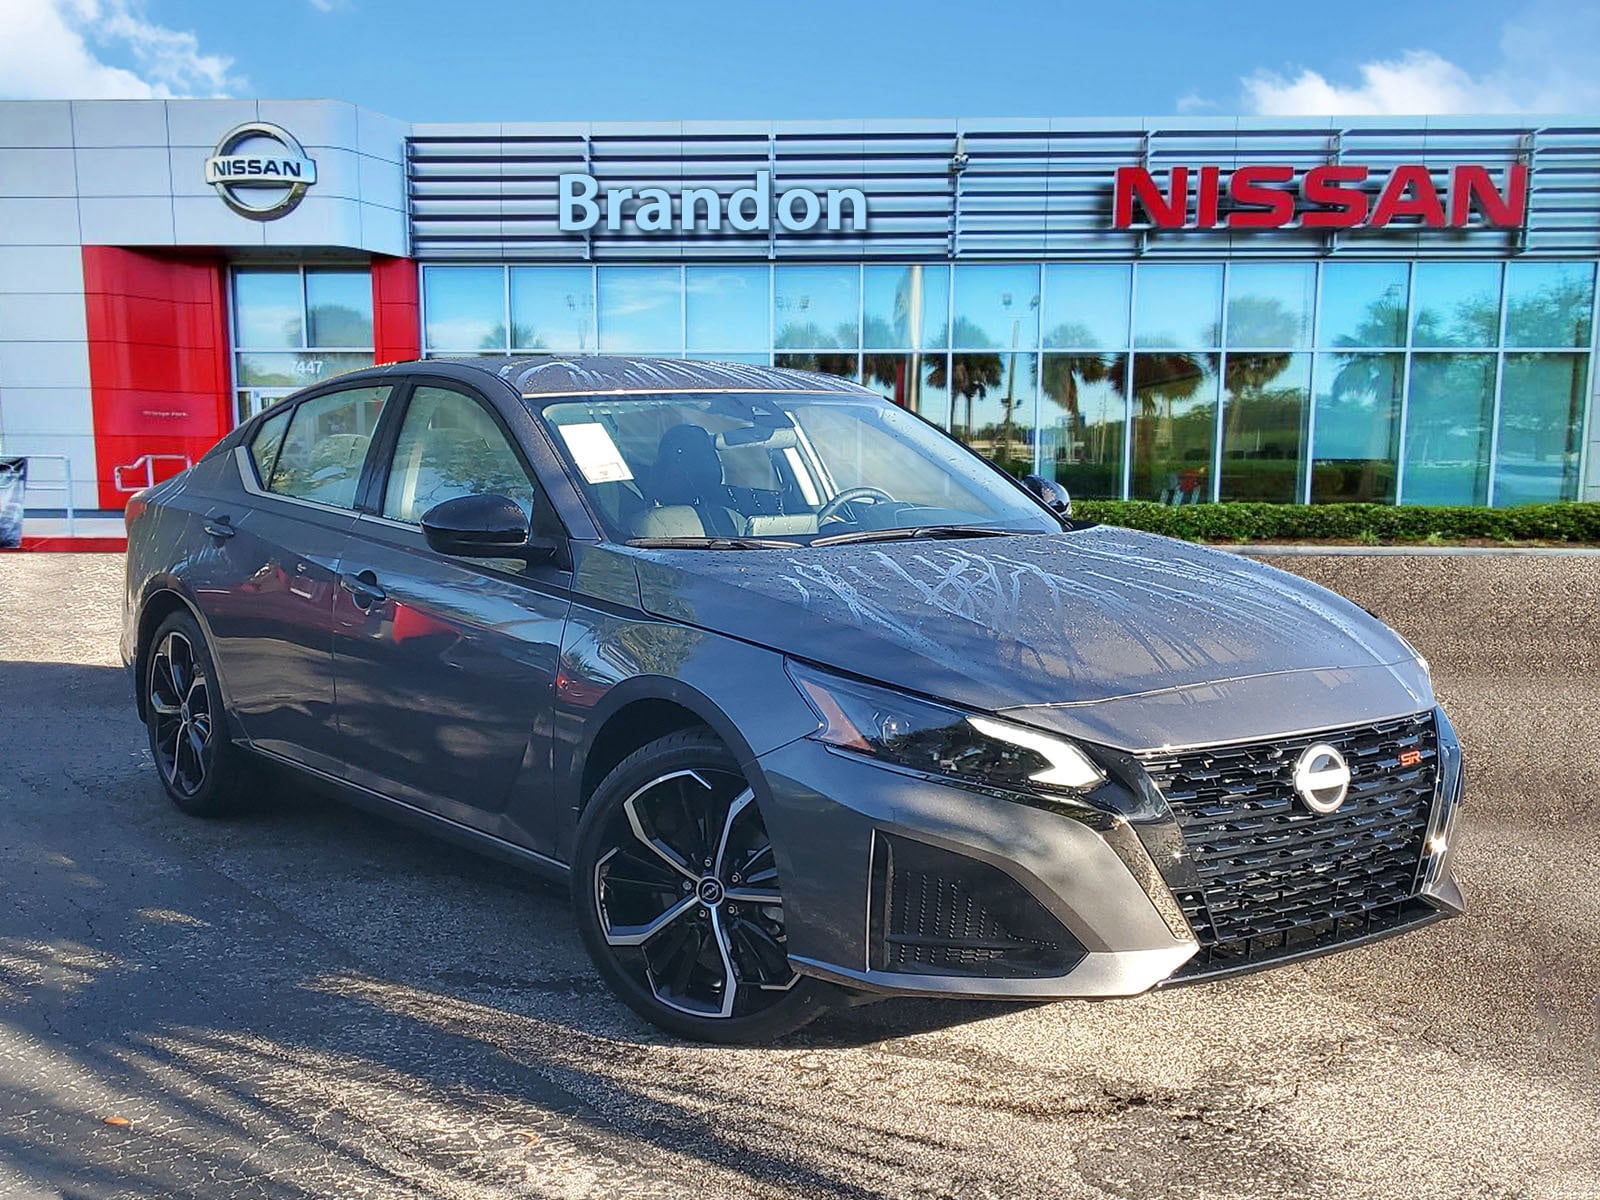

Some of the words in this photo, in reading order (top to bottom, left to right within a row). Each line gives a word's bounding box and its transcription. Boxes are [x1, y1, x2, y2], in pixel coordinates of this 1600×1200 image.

[213, 159, 301, 177] NISSAN
[559, 170, 867, 231] Brandon
[1113, 164, 1528, 229] NISSAN
[292, 360, 323, 375] 7447
[1400, 750, 1421, 766] SR
